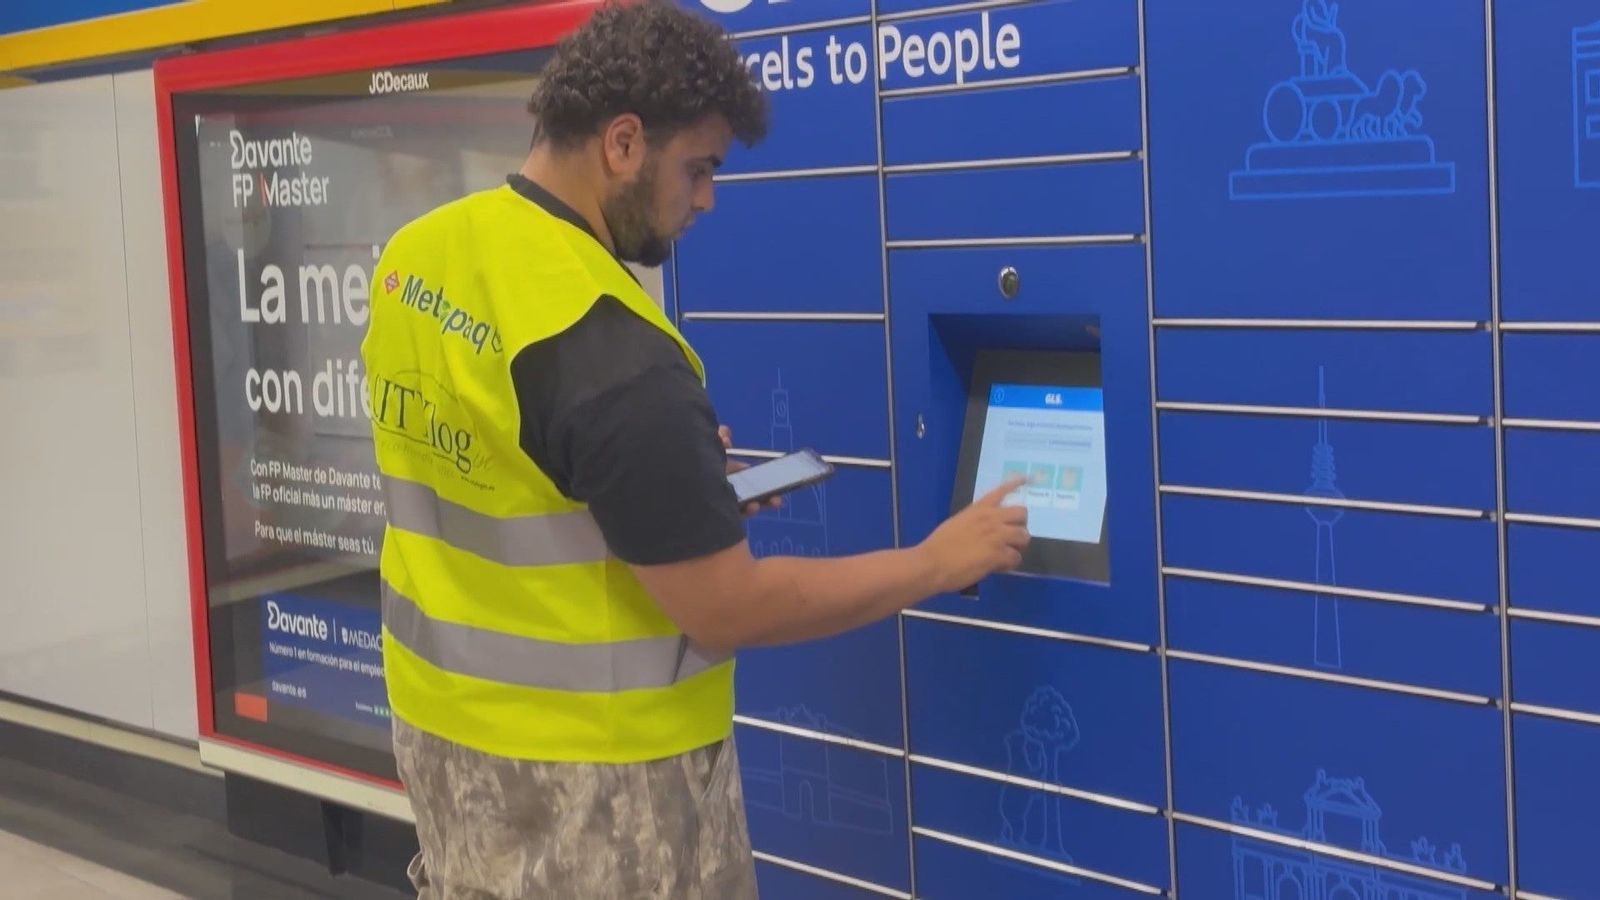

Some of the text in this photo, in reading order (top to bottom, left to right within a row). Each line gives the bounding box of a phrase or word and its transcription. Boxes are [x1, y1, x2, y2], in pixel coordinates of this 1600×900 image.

[736, 10, 1021, 92] cels to People
[369, 71, 430, 94] JCDecaux
[229, 129, 313, 169] Davante
[232, 171, 329, 208] FP Master
[237, 244, 380, 326] La me
[245, 367, 303, 414] con
[250, 458, 268, 478] Con
[269, 460, 281, 478] FP
[282, 462, 312, 482] Master
[314, 467, 327, 484] de
[328, 466, 370, 490] Davante
[252, 481, 260, 500] la
[260, 483, 271, 501] FP
[273, 485, 301, 505] oficial
[302, 488, 320, 509] más
[321, 494, 335, 510] un
[337, 493, 372, 514] máster
[254, 520, 377, 555] Para que el máster seas tú.
[267, 599, 328, 641] Davante
[269, 641, 293, 658] Número
[298, 649, 307, 661] en
[307, 648, 338, 667] formación
[338, 657, 352, 671] para
[353, 662, 360, 673] el
